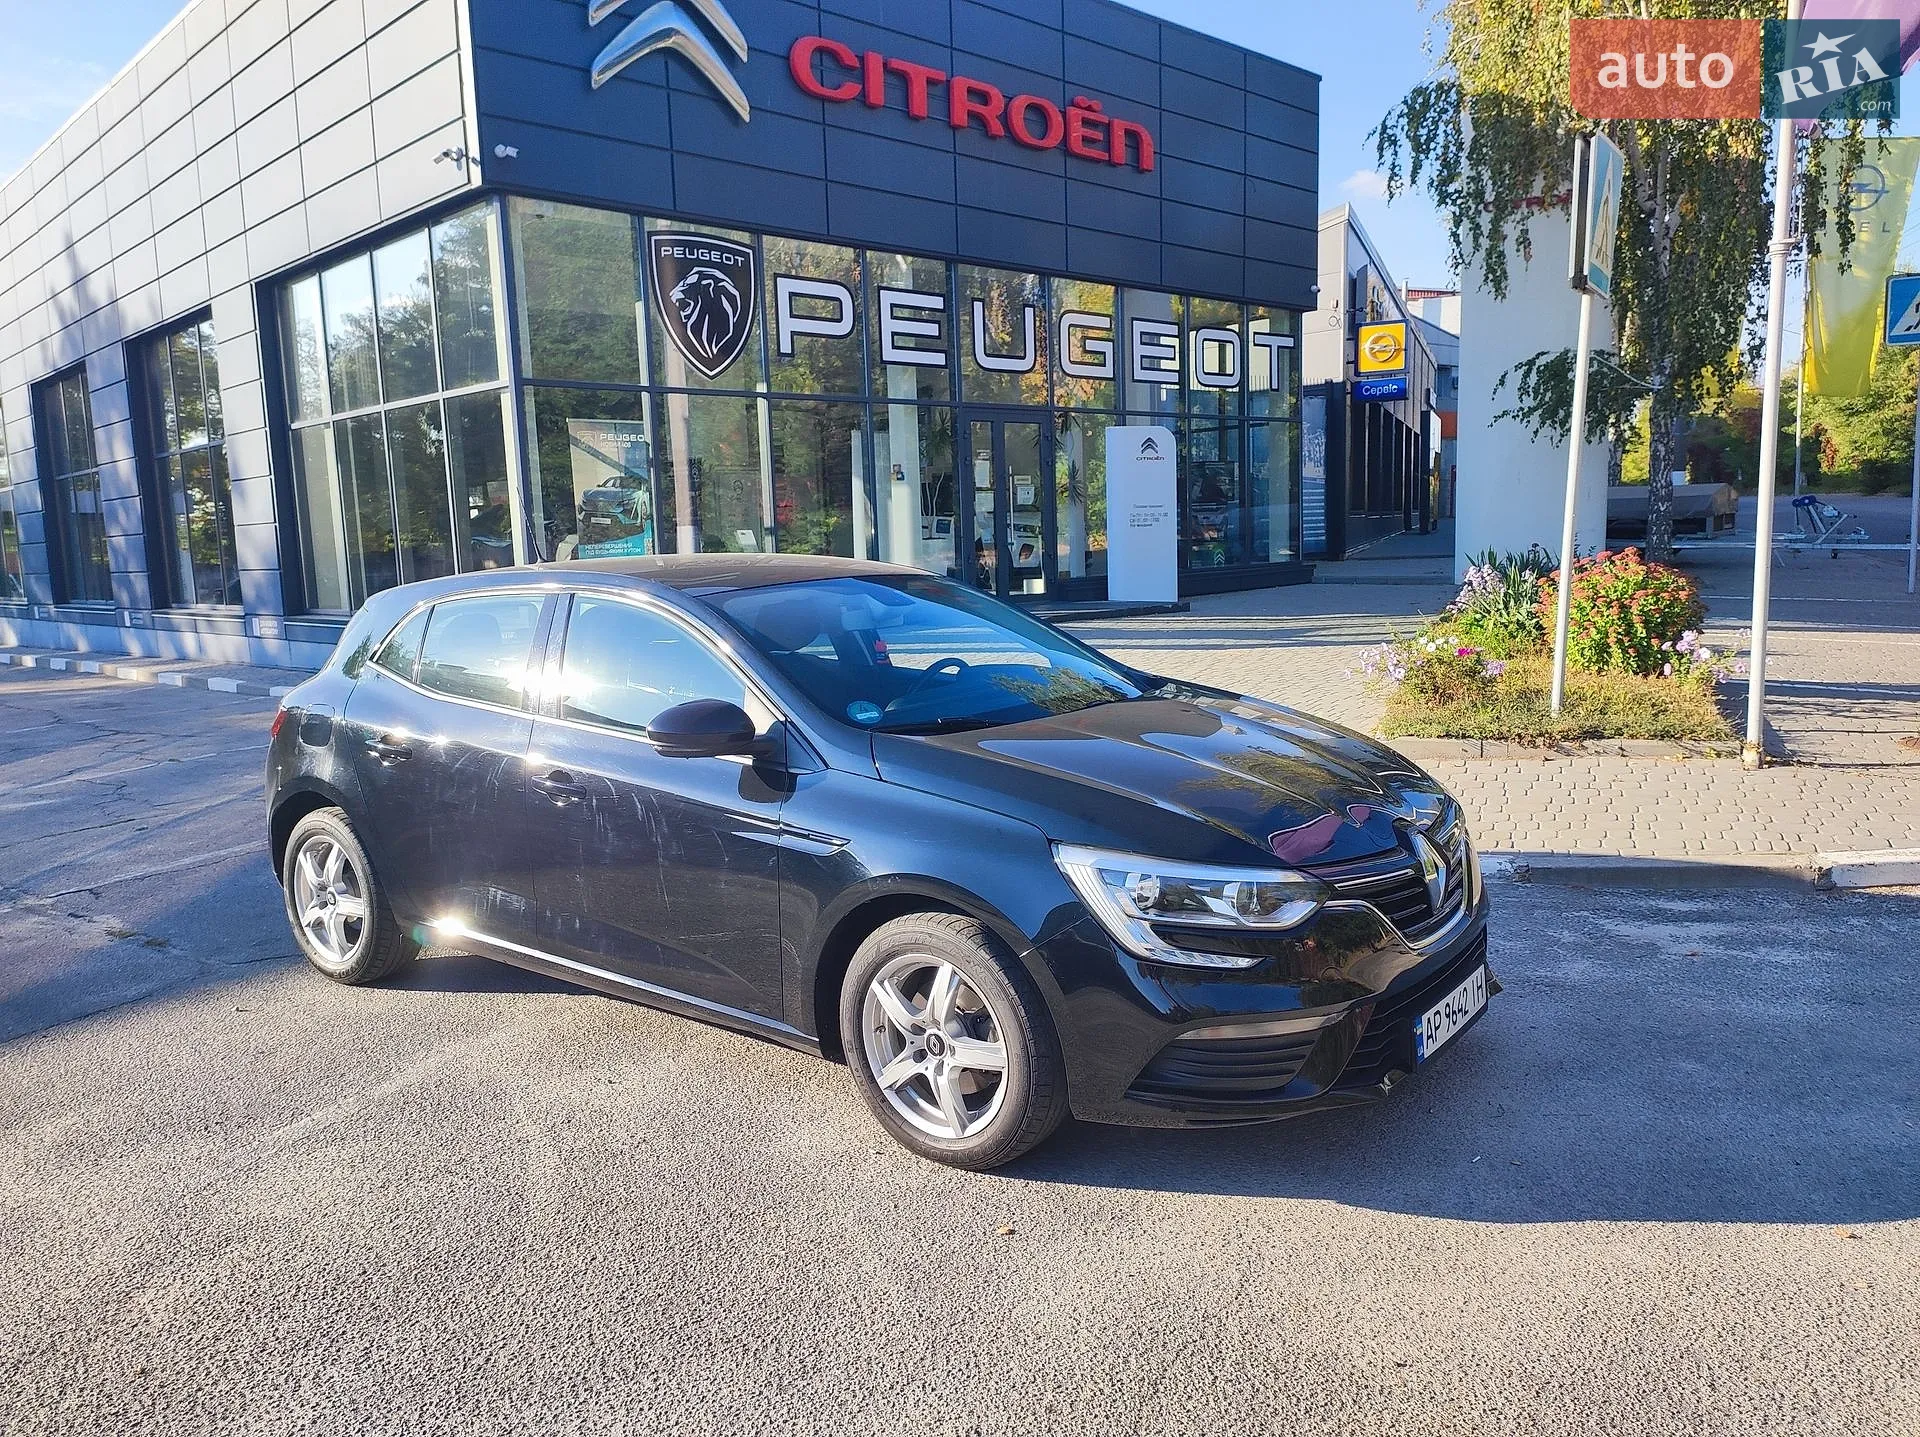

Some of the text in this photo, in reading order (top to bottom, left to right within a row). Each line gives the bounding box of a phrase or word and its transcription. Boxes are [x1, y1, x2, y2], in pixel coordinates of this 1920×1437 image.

[789, 35, 1155, 173] CITROËN
[660, 246, 745, 267] PEUGEOT
[774, 273, 1295, 392] PEUGEOT
[600, 433, 645, 442] PEUGEO
[1426, 973, 1484, 1049] AP 9642 IH
